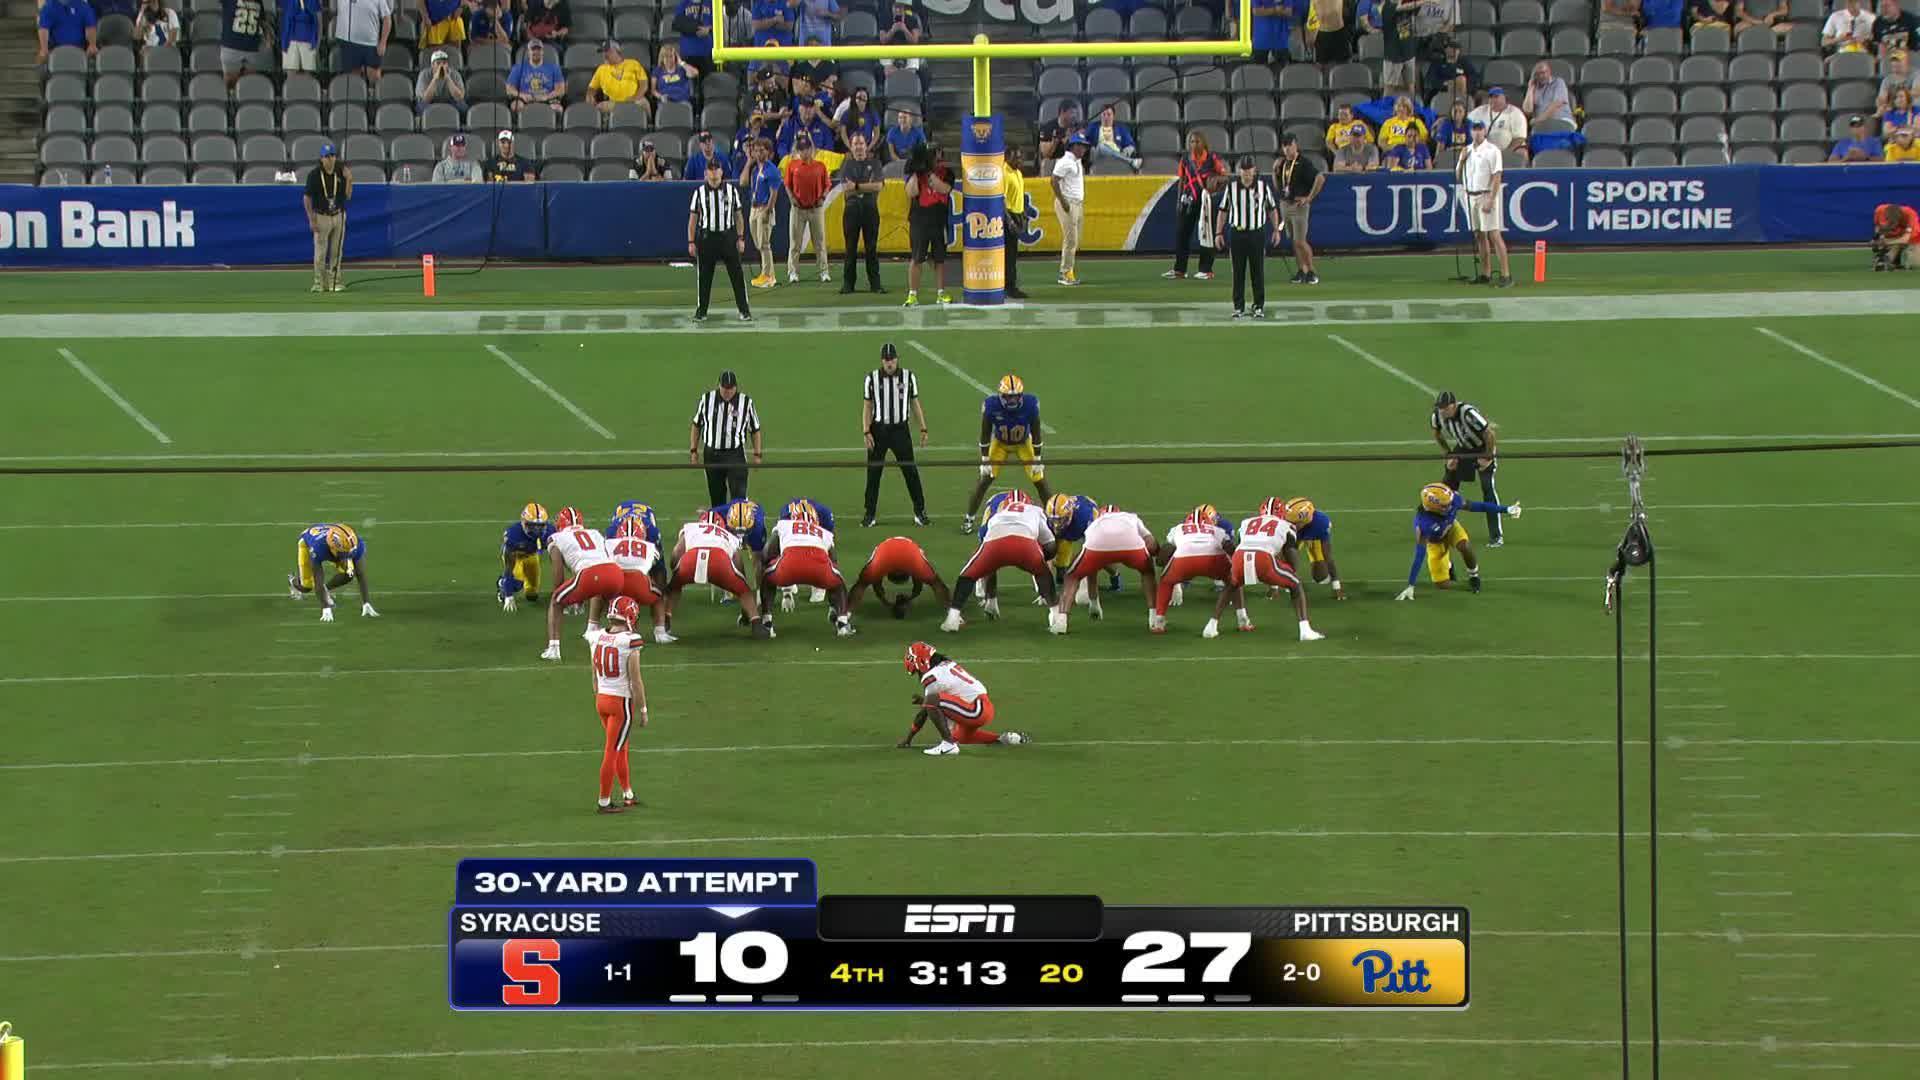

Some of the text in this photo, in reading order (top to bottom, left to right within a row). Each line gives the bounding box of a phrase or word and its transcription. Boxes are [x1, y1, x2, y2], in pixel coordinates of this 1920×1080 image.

[1587, 180, 1705, 203] SPORTS
[61, 200, 195, 248] Bank
[1587, 207, 1733, 231] MEDICINE
[999, 424, 1025, 442] 10
[573, 531, 596, 551] 0
[593, 644, 620, 678] 40
